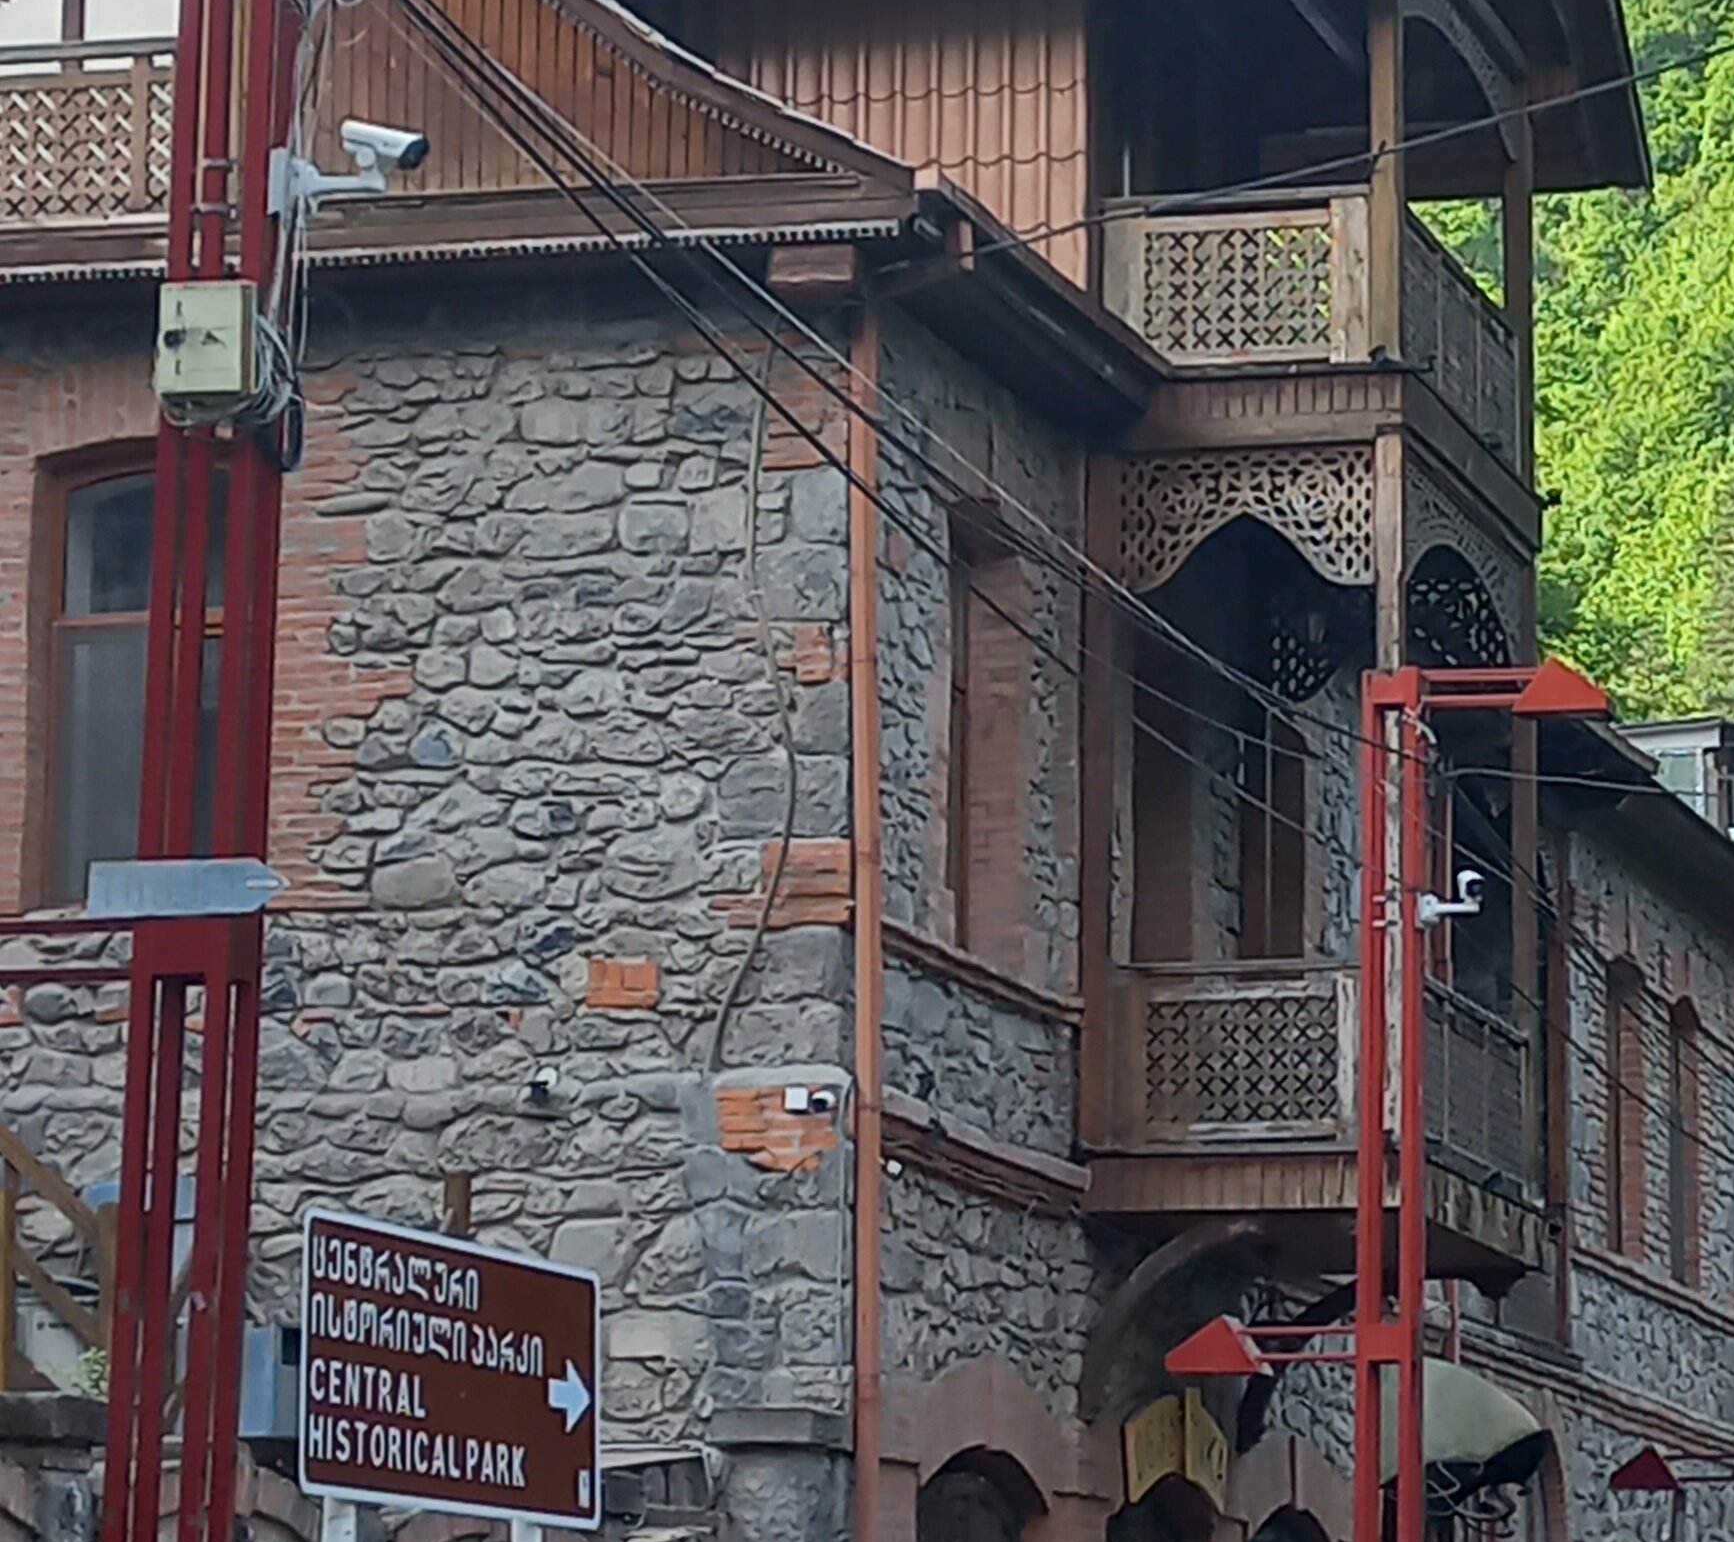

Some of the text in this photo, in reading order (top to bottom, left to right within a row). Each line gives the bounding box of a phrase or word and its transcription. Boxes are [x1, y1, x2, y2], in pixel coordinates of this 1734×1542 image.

[311, 1234, 480, 1312] ცენტრალური
[310, 1291, 544, 1378] ისტორიული პარკი
[309, 1357, 427, 1419] CENTRAL
[308, 1413, 527, 1489] HISTORICAL PARK
